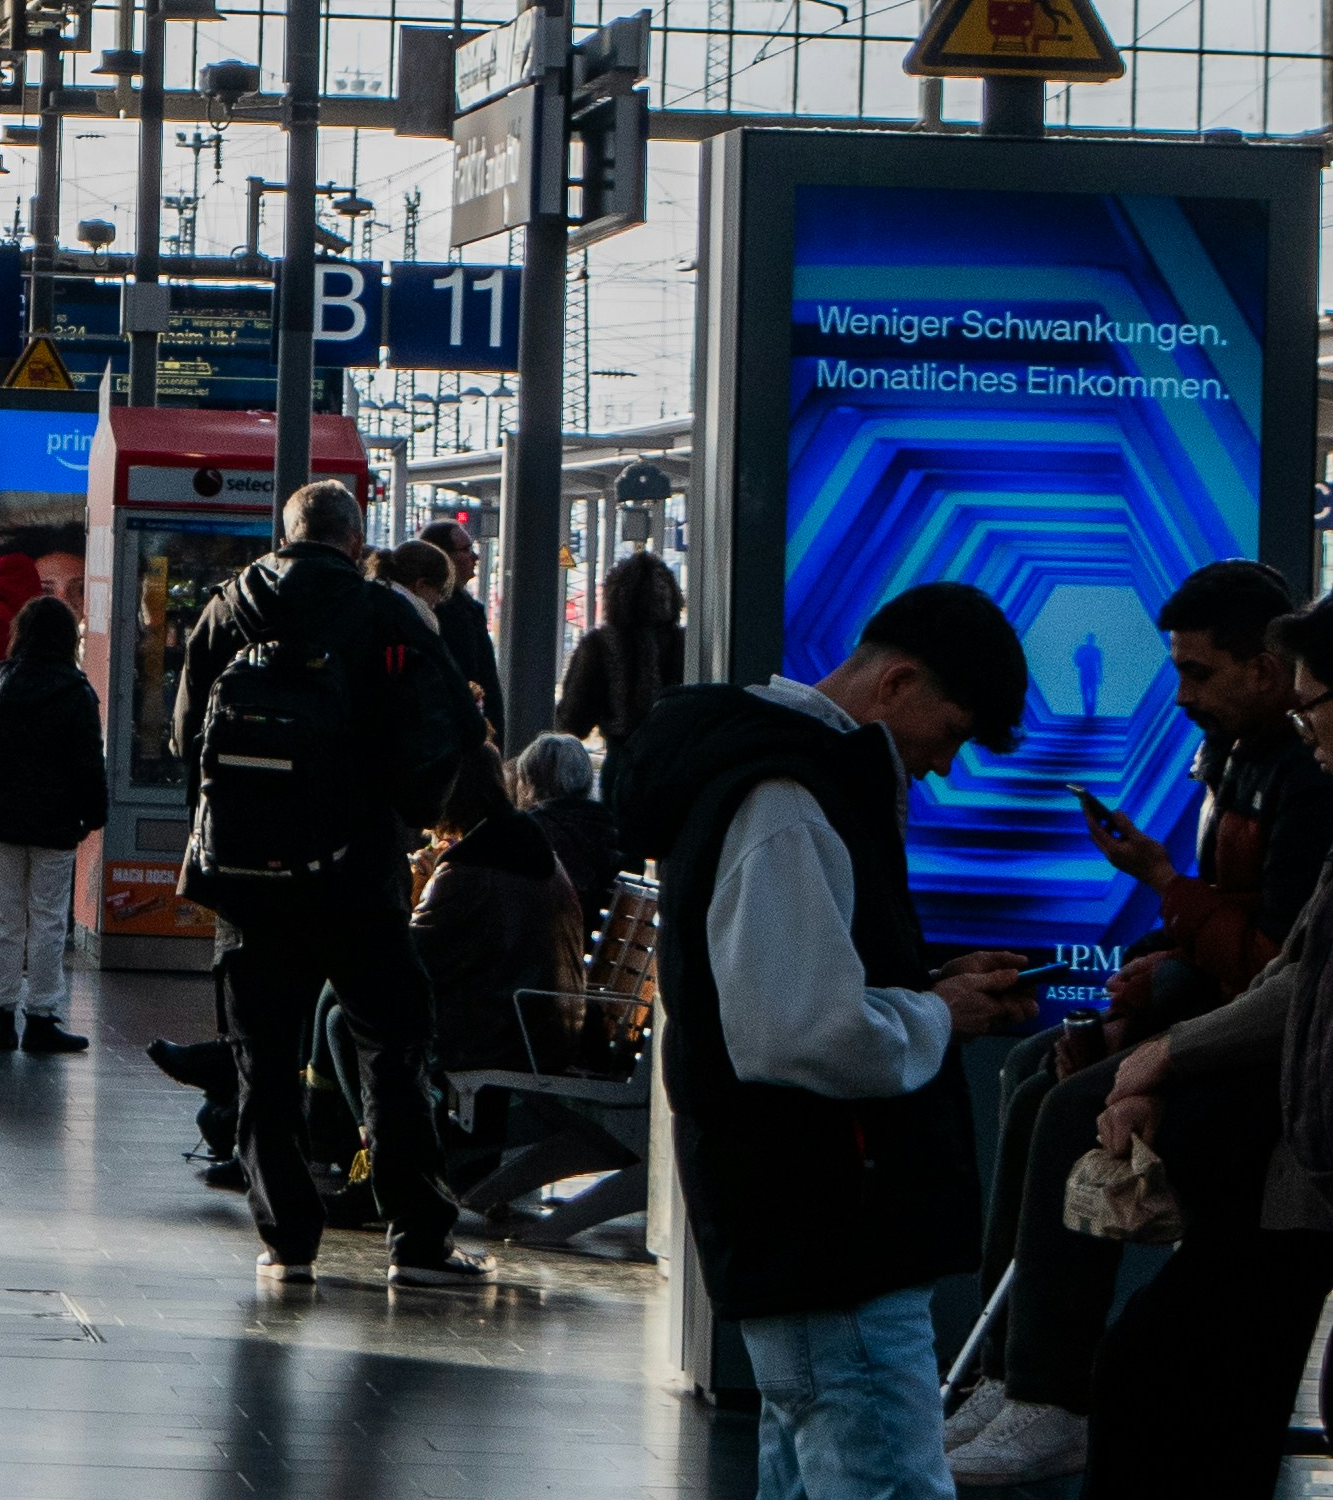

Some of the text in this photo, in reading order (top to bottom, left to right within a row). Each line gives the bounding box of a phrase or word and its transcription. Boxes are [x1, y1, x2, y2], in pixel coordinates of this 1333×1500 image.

[312, 263, 504, 347] B 11
[817, 304, 1228, 351] Weniger Schwankungen.
[816, 359, 1231, 400] Monatliches Einkommen.
[1045, 985, 1096, 1001] ASSET
